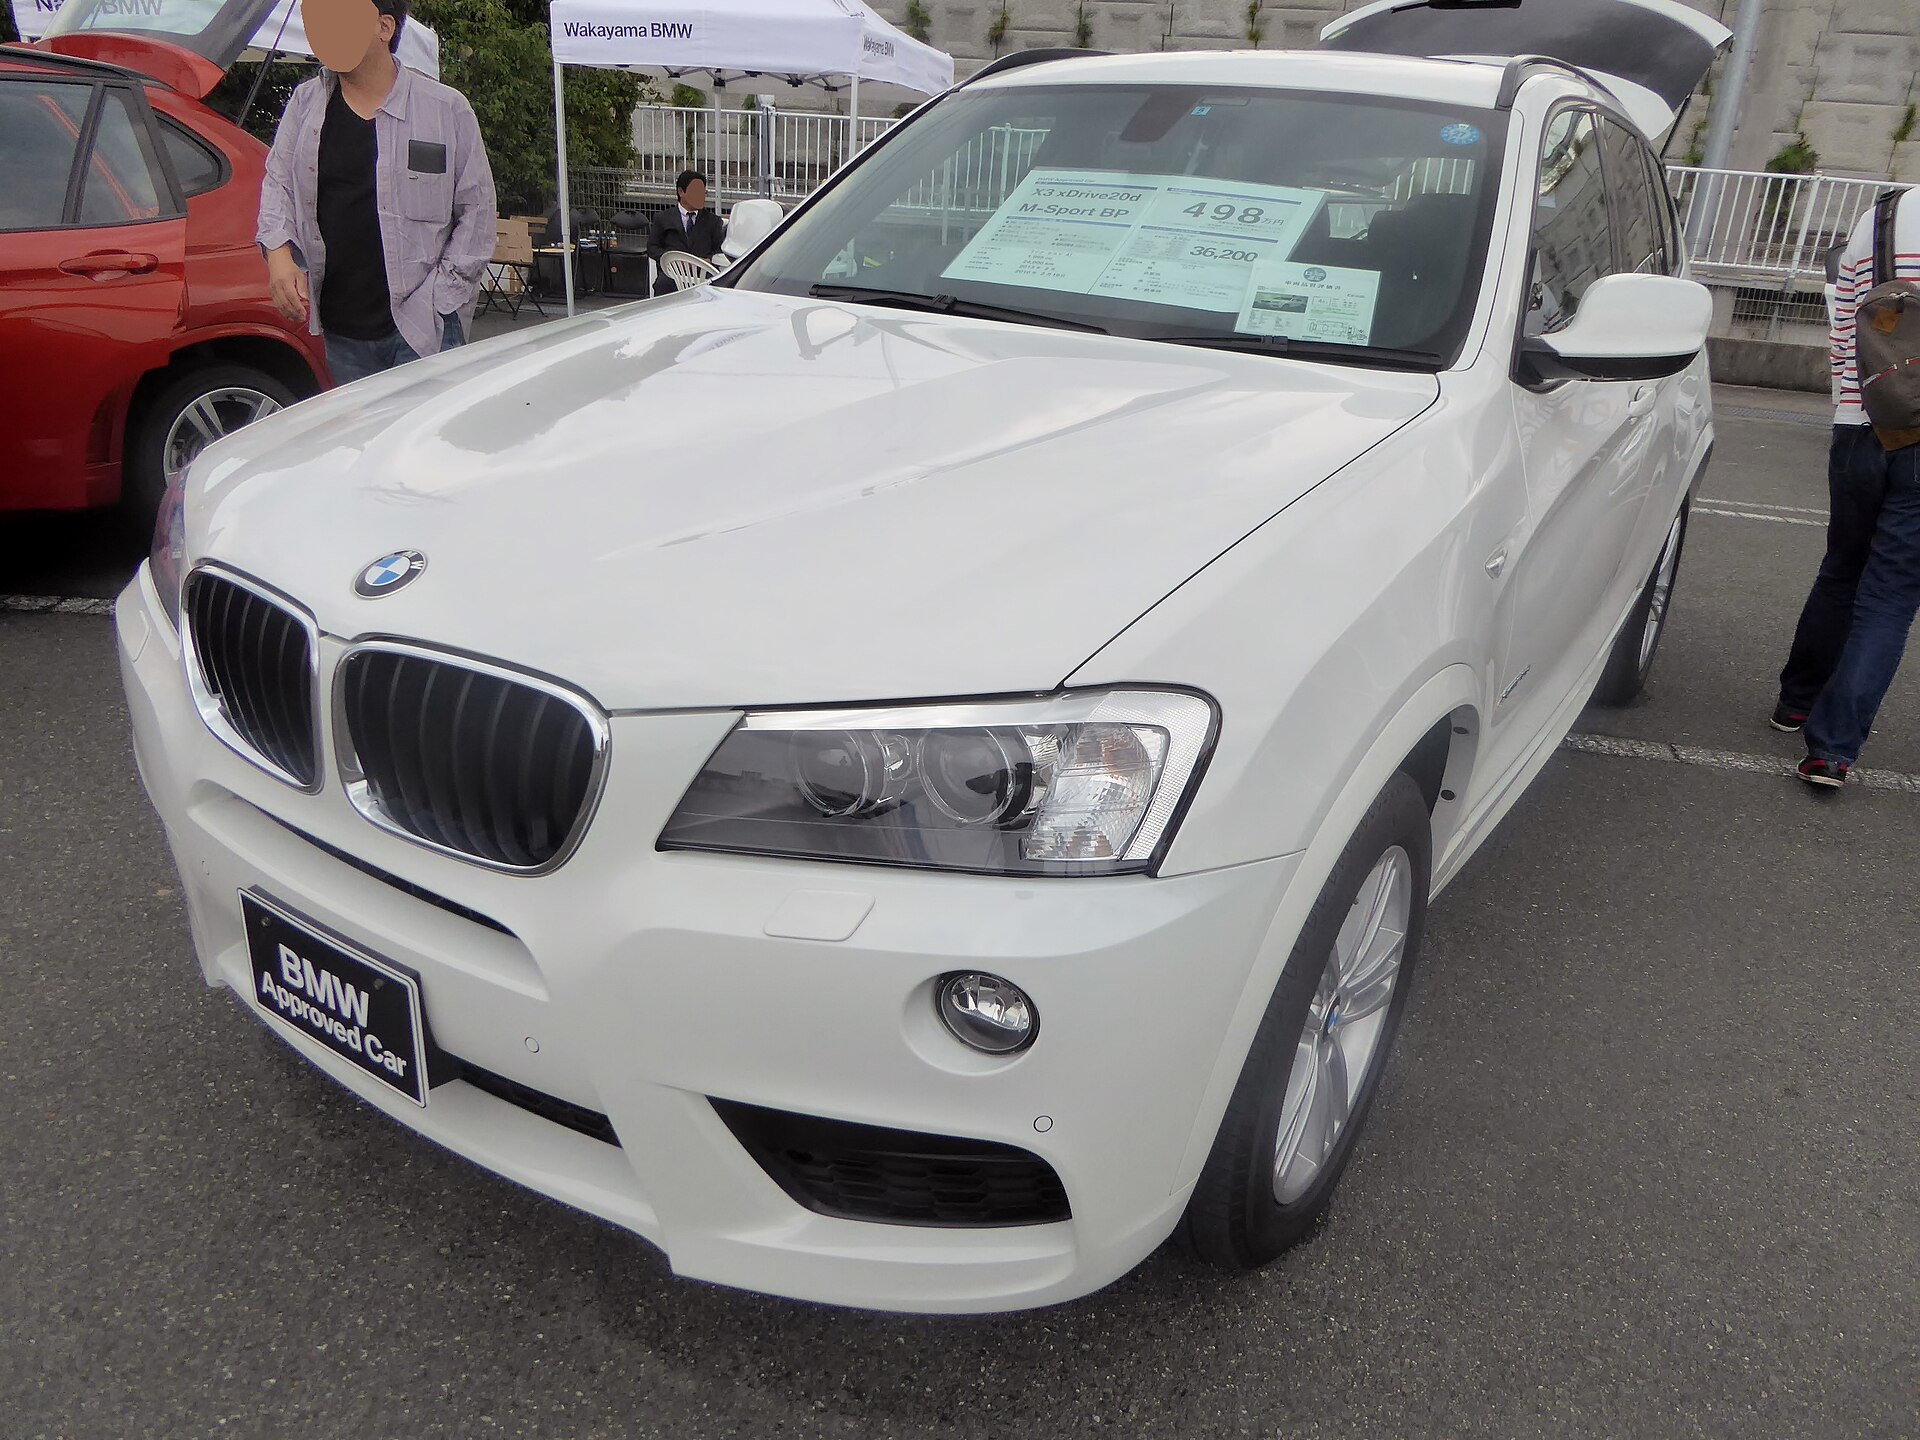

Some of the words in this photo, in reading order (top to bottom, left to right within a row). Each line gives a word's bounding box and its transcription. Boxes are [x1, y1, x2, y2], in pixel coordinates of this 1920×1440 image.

[563, 22, 648, 40] Wakayama
[650, 22, 694, 39] BMW
[1032, 187, 1056, 197] X3
[1057, 188, 1143, 202] xDrive20d
[1018, 202, 1097, 217] M-Sport
[1099, 207, 1130, 218] BP
[1189, 245, 1259, 262] 36,200
[278, 942, 370, 1028] BMW
[262, 970, 363, 1053] Approved
[364, 1032, 408, 1077] Car
